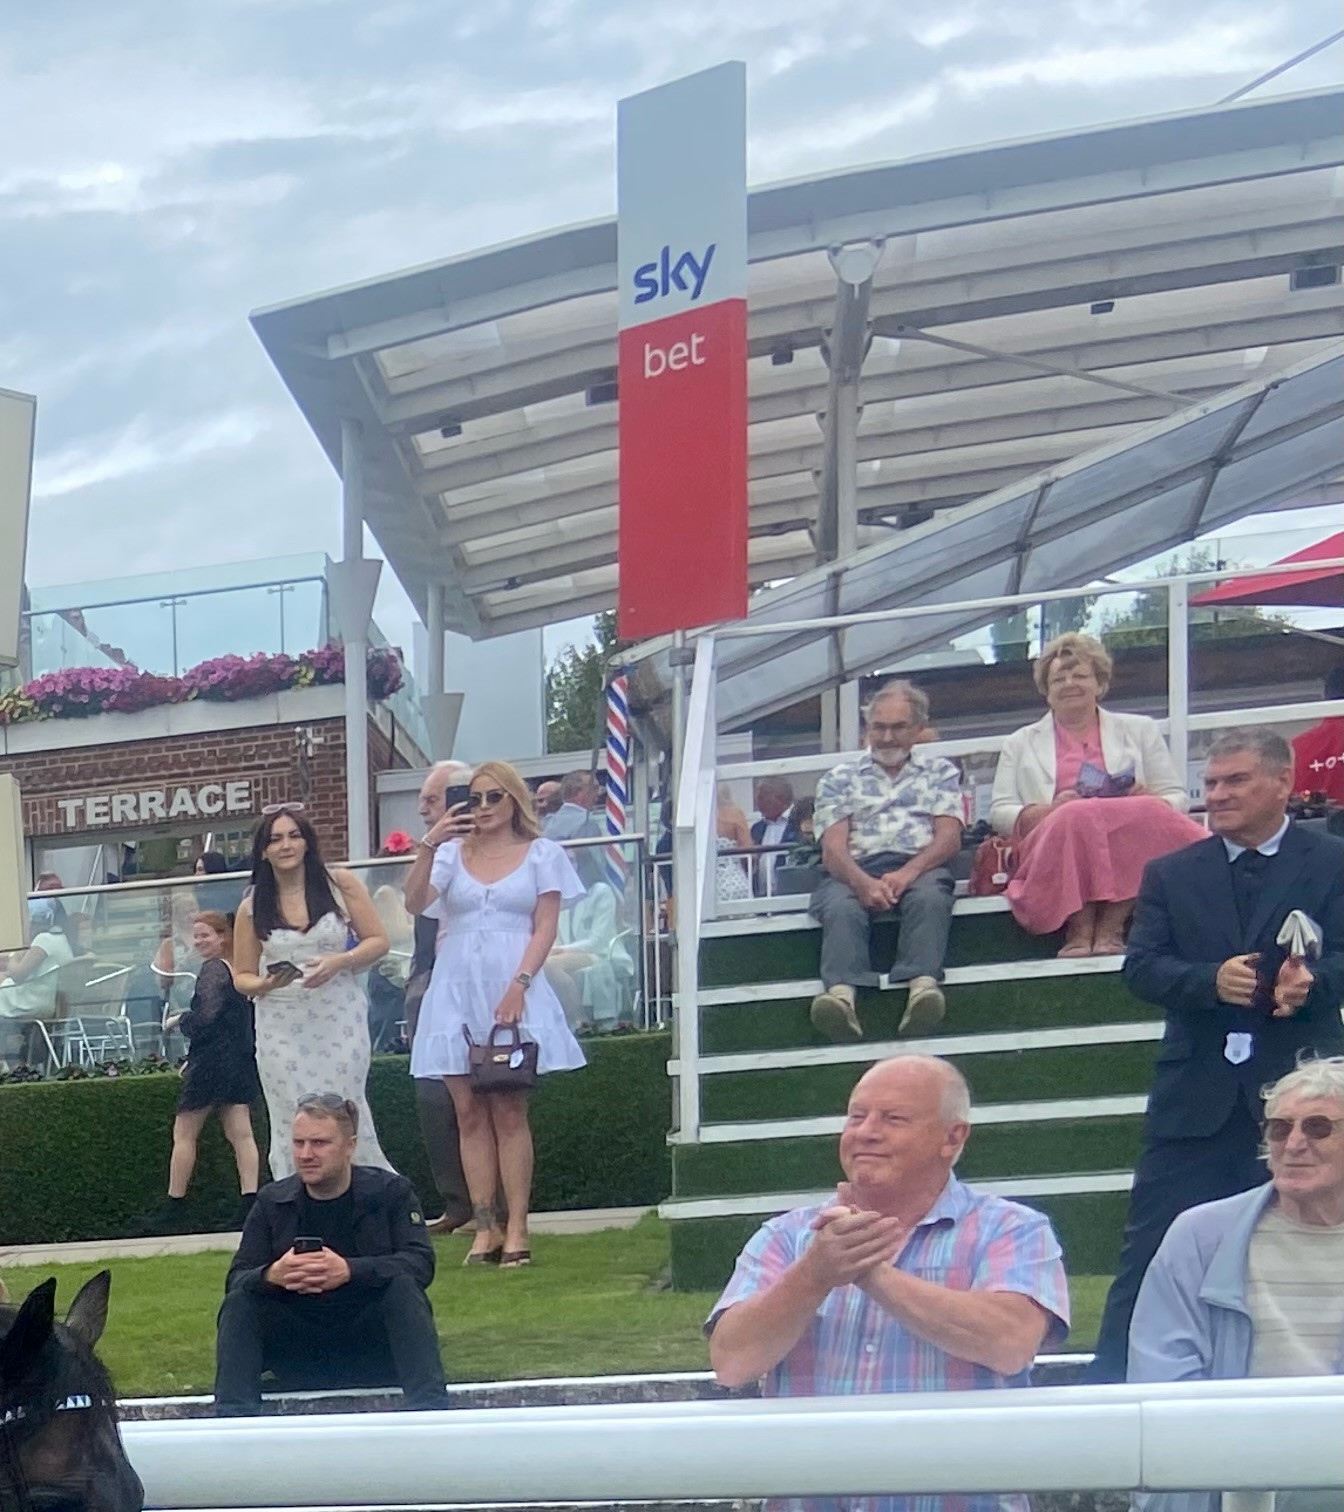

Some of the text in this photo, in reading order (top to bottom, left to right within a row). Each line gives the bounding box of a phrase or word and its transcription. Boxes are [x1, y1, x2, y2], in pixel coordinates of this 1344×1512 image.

[633, 243, 716, 304] sky
[644, 333, 706, 379] bet
[57, 781, 253, 827] TERRACE
